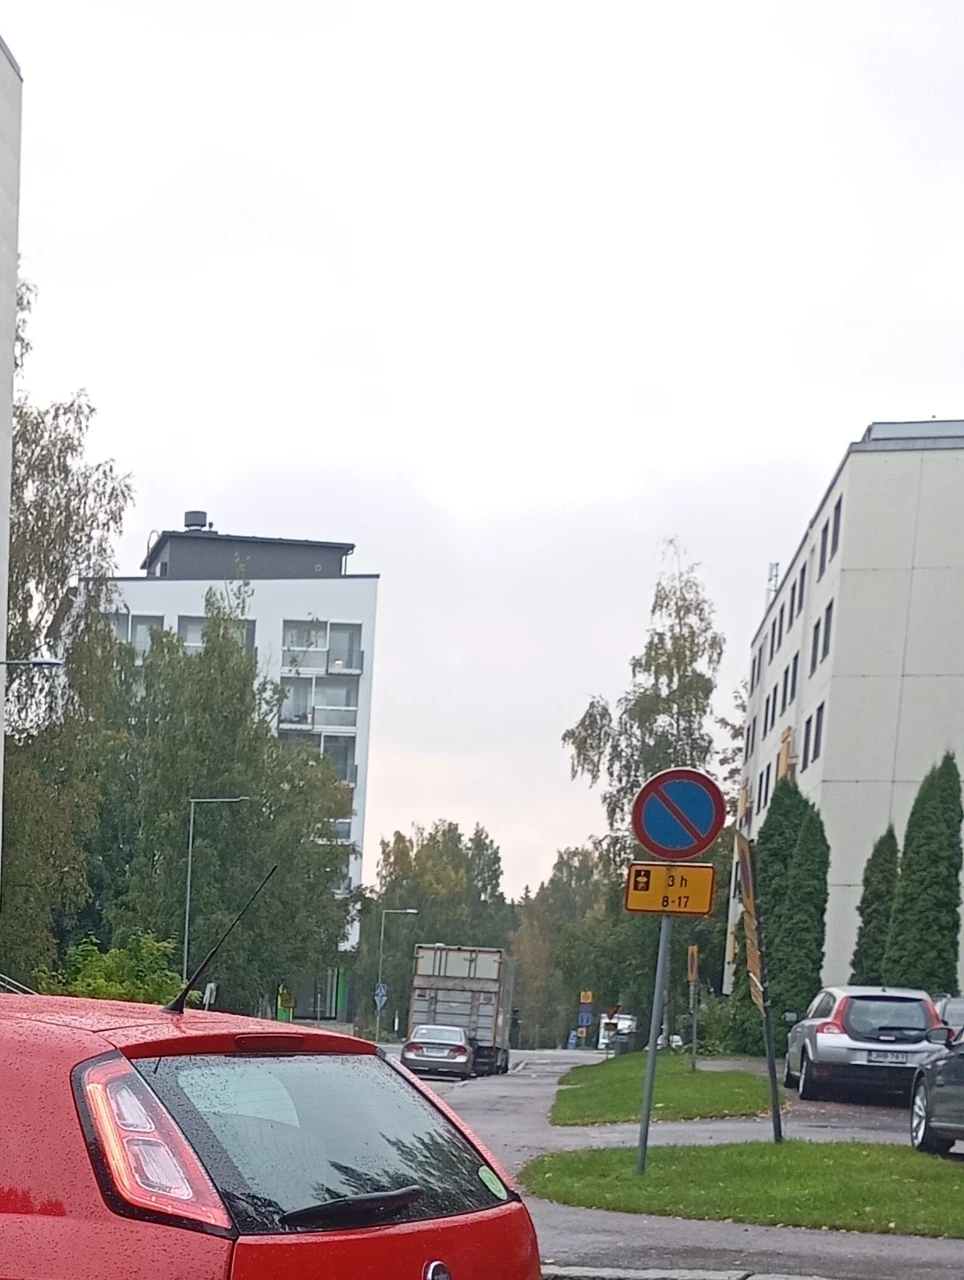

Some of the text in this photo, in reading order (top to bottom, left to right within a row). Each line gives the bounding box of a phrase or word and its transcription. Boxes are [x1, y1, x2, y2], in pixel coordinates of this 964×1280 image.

[668, 875, 687, 887] 3 h
[661, 895, 689, 908] 8-17
